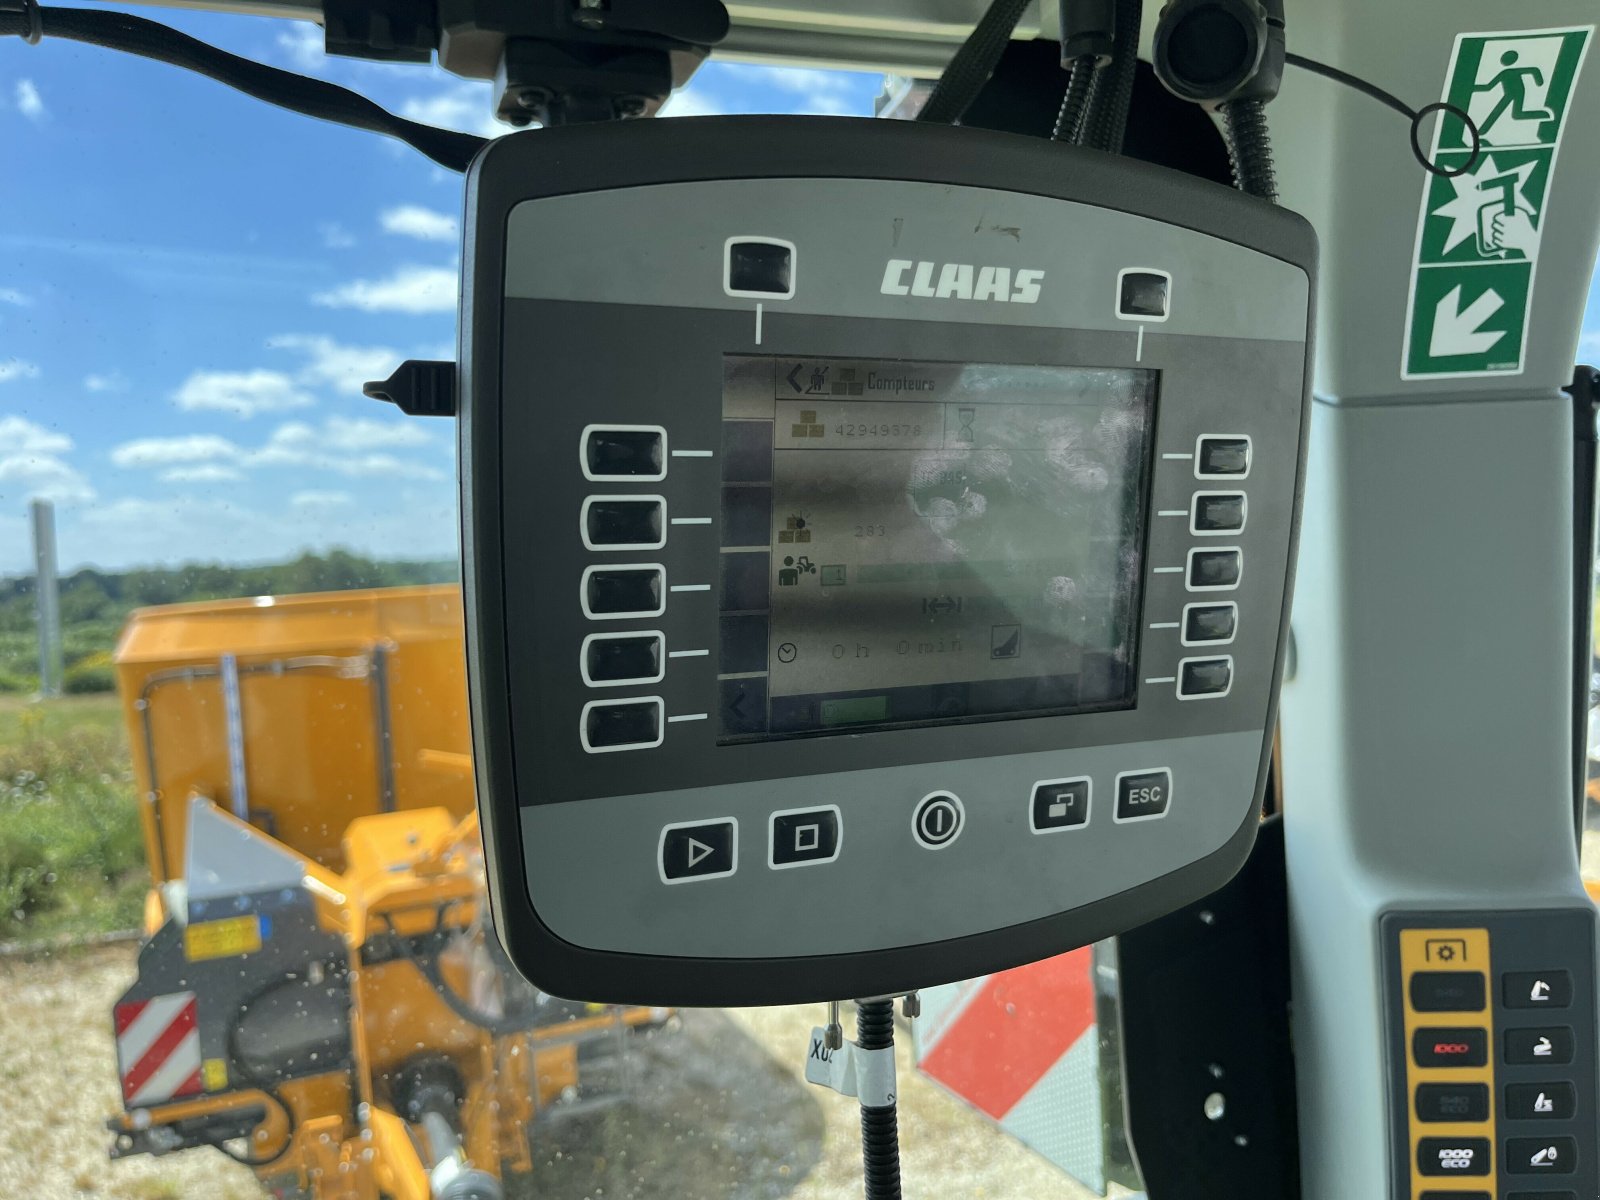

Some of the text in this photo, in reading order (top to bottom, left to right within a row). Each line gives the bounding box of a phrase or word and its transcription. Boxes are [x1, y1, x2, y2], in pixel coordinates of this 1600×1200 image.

[880, 258, 1046, 304] CLAAS
[867, 371, 936, 395] Compteurs
[1129, 786, 1161, 805] ESC
[1434, 1043, 1469, 1053] 1000
[1438, 1149, 1474, 1159] 1000
